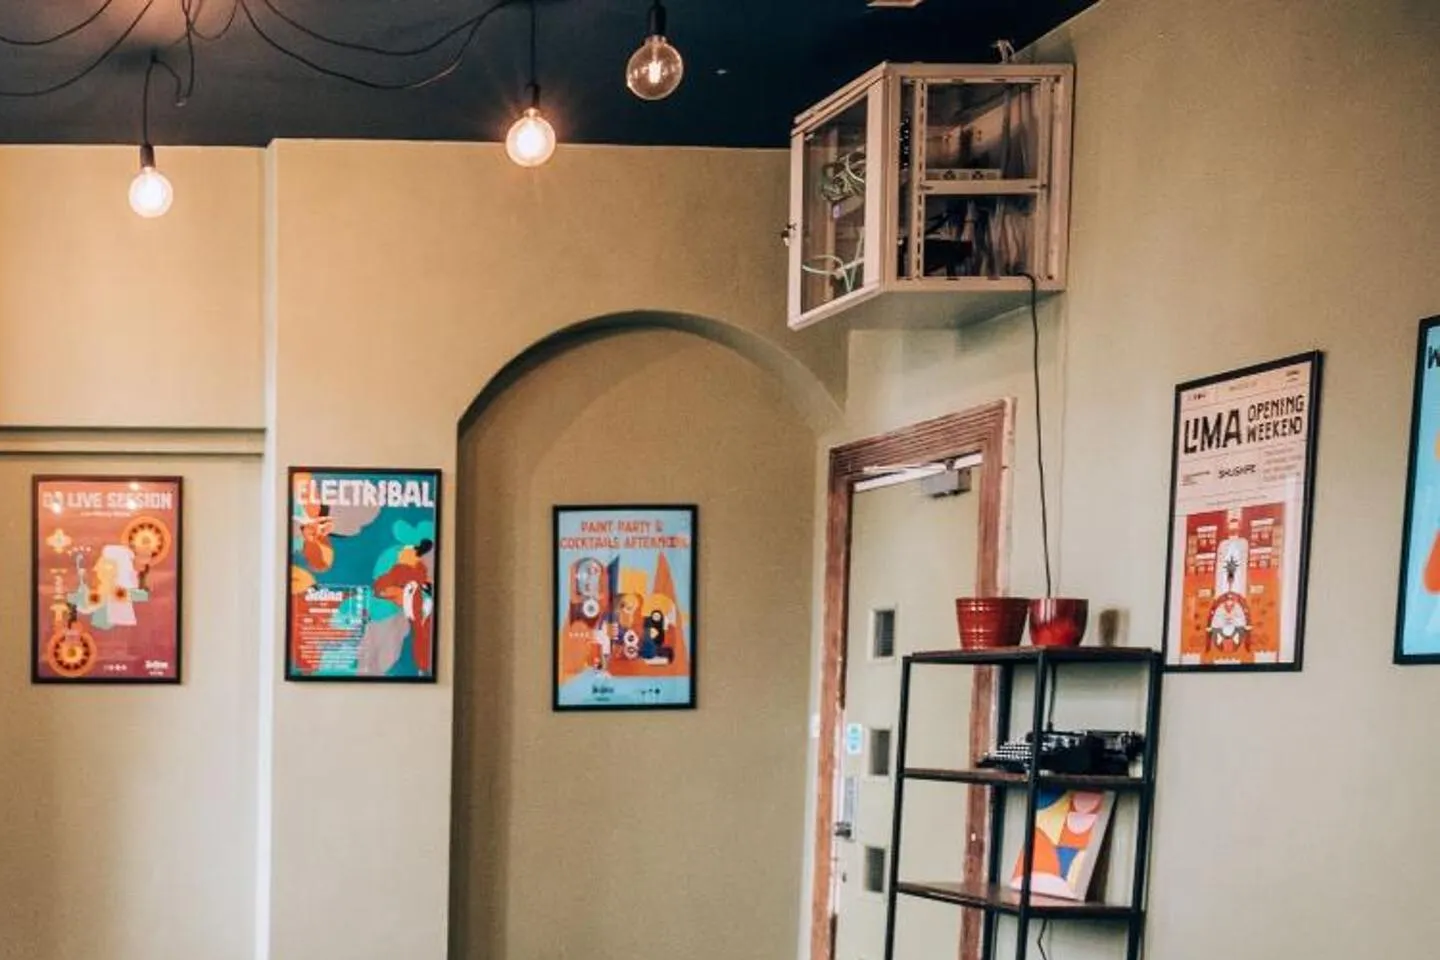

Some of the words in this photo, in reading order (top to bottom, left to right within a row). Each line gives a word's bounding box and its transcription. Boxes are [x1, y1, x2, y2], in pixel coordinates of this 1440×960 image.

[1247, 395, 1305, 422] OPENING
[1184, 409, 1243, 454] LIMA
[1247, 416, 1303, 443] WEEKEND
[67, 492, 103, 509] LIVE
[295, 479, 434, 507] ELECTRIBAL
